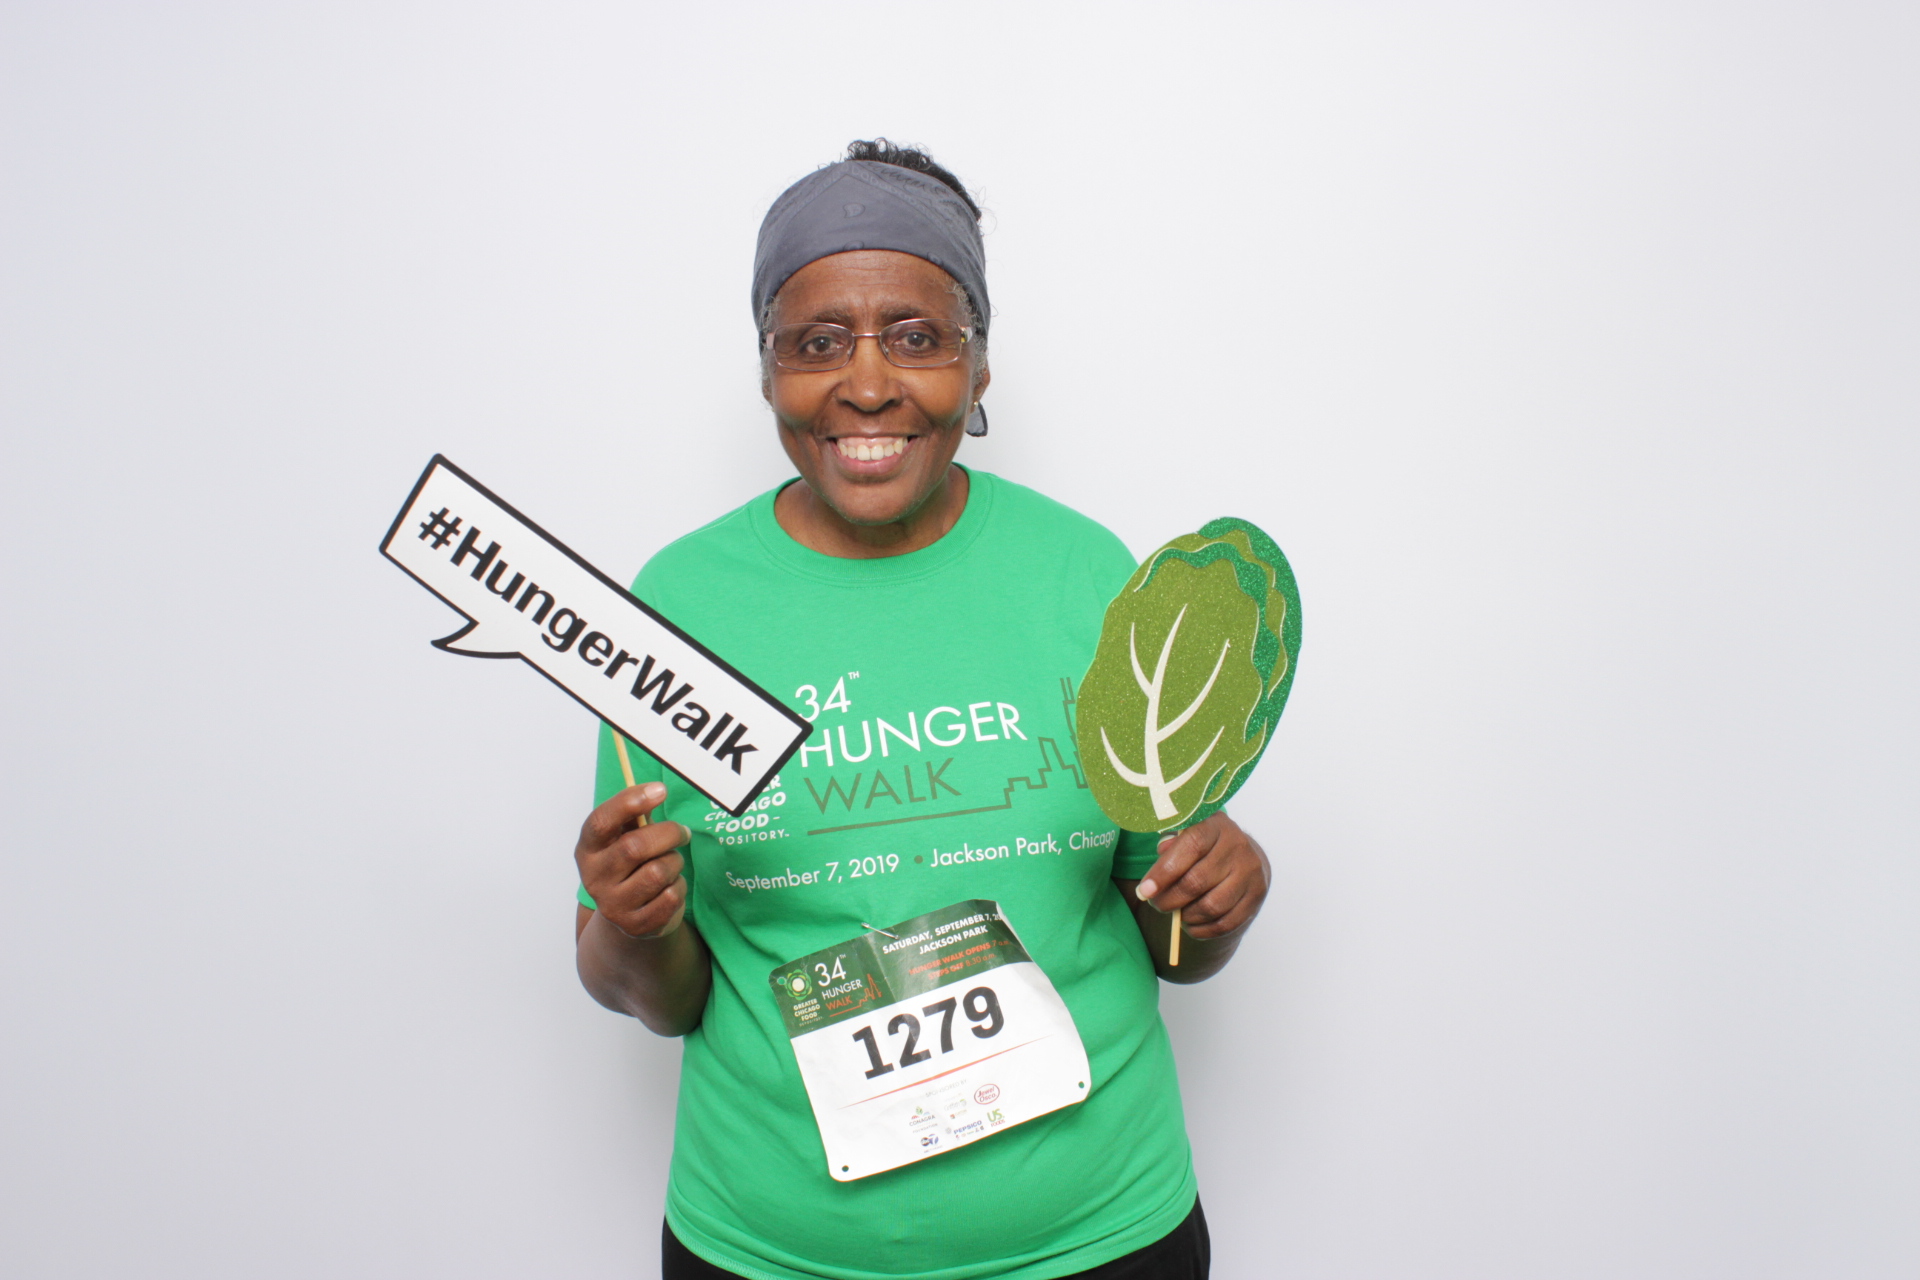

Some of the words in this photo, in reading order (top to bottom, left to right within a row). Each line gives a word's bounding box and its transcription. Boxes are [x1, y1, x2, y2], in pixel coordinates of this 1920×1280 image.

[418, 507, 759, 775] #HungerWalk
[800, 701, 1028, 768] HUNGER
[803, 757, 962, 815] WALK
[726, 868, 820, 893] September
[826, 862, 842, 883] 7,
[849, 854, 899, 878] 2019
[930, 843, 1009, 867] Jackson
[1016, 833, 1062, 855] Park,
[1069, 829, 1116, 851] Chicago
[882, 931, 933, 954] SATURDAY,
[935, 914, 985, 936] SEPTEMBER
[920, 933, 963, 954] JACKSON
[963, 925, 988, 939] PARK
[909, 960, 942, 975] HUNGER
[942, 952, 965, 967] WALK
[966, 942, 991, 955] OPENS
[928, 966, 950, 980] STEPS
[821, 979, 863, 1000] HUNGER
[826, 995, 853, 1011] WALK
[793, 998, 817, 1011] GREATER
[794, 1004, 820, 1017] CHICAGO
[801, 1012, 818, 1021] FOOD
[852, 986, 1004, 1079] 1279
[953, 1120, 983, 1134] PEPSICO
